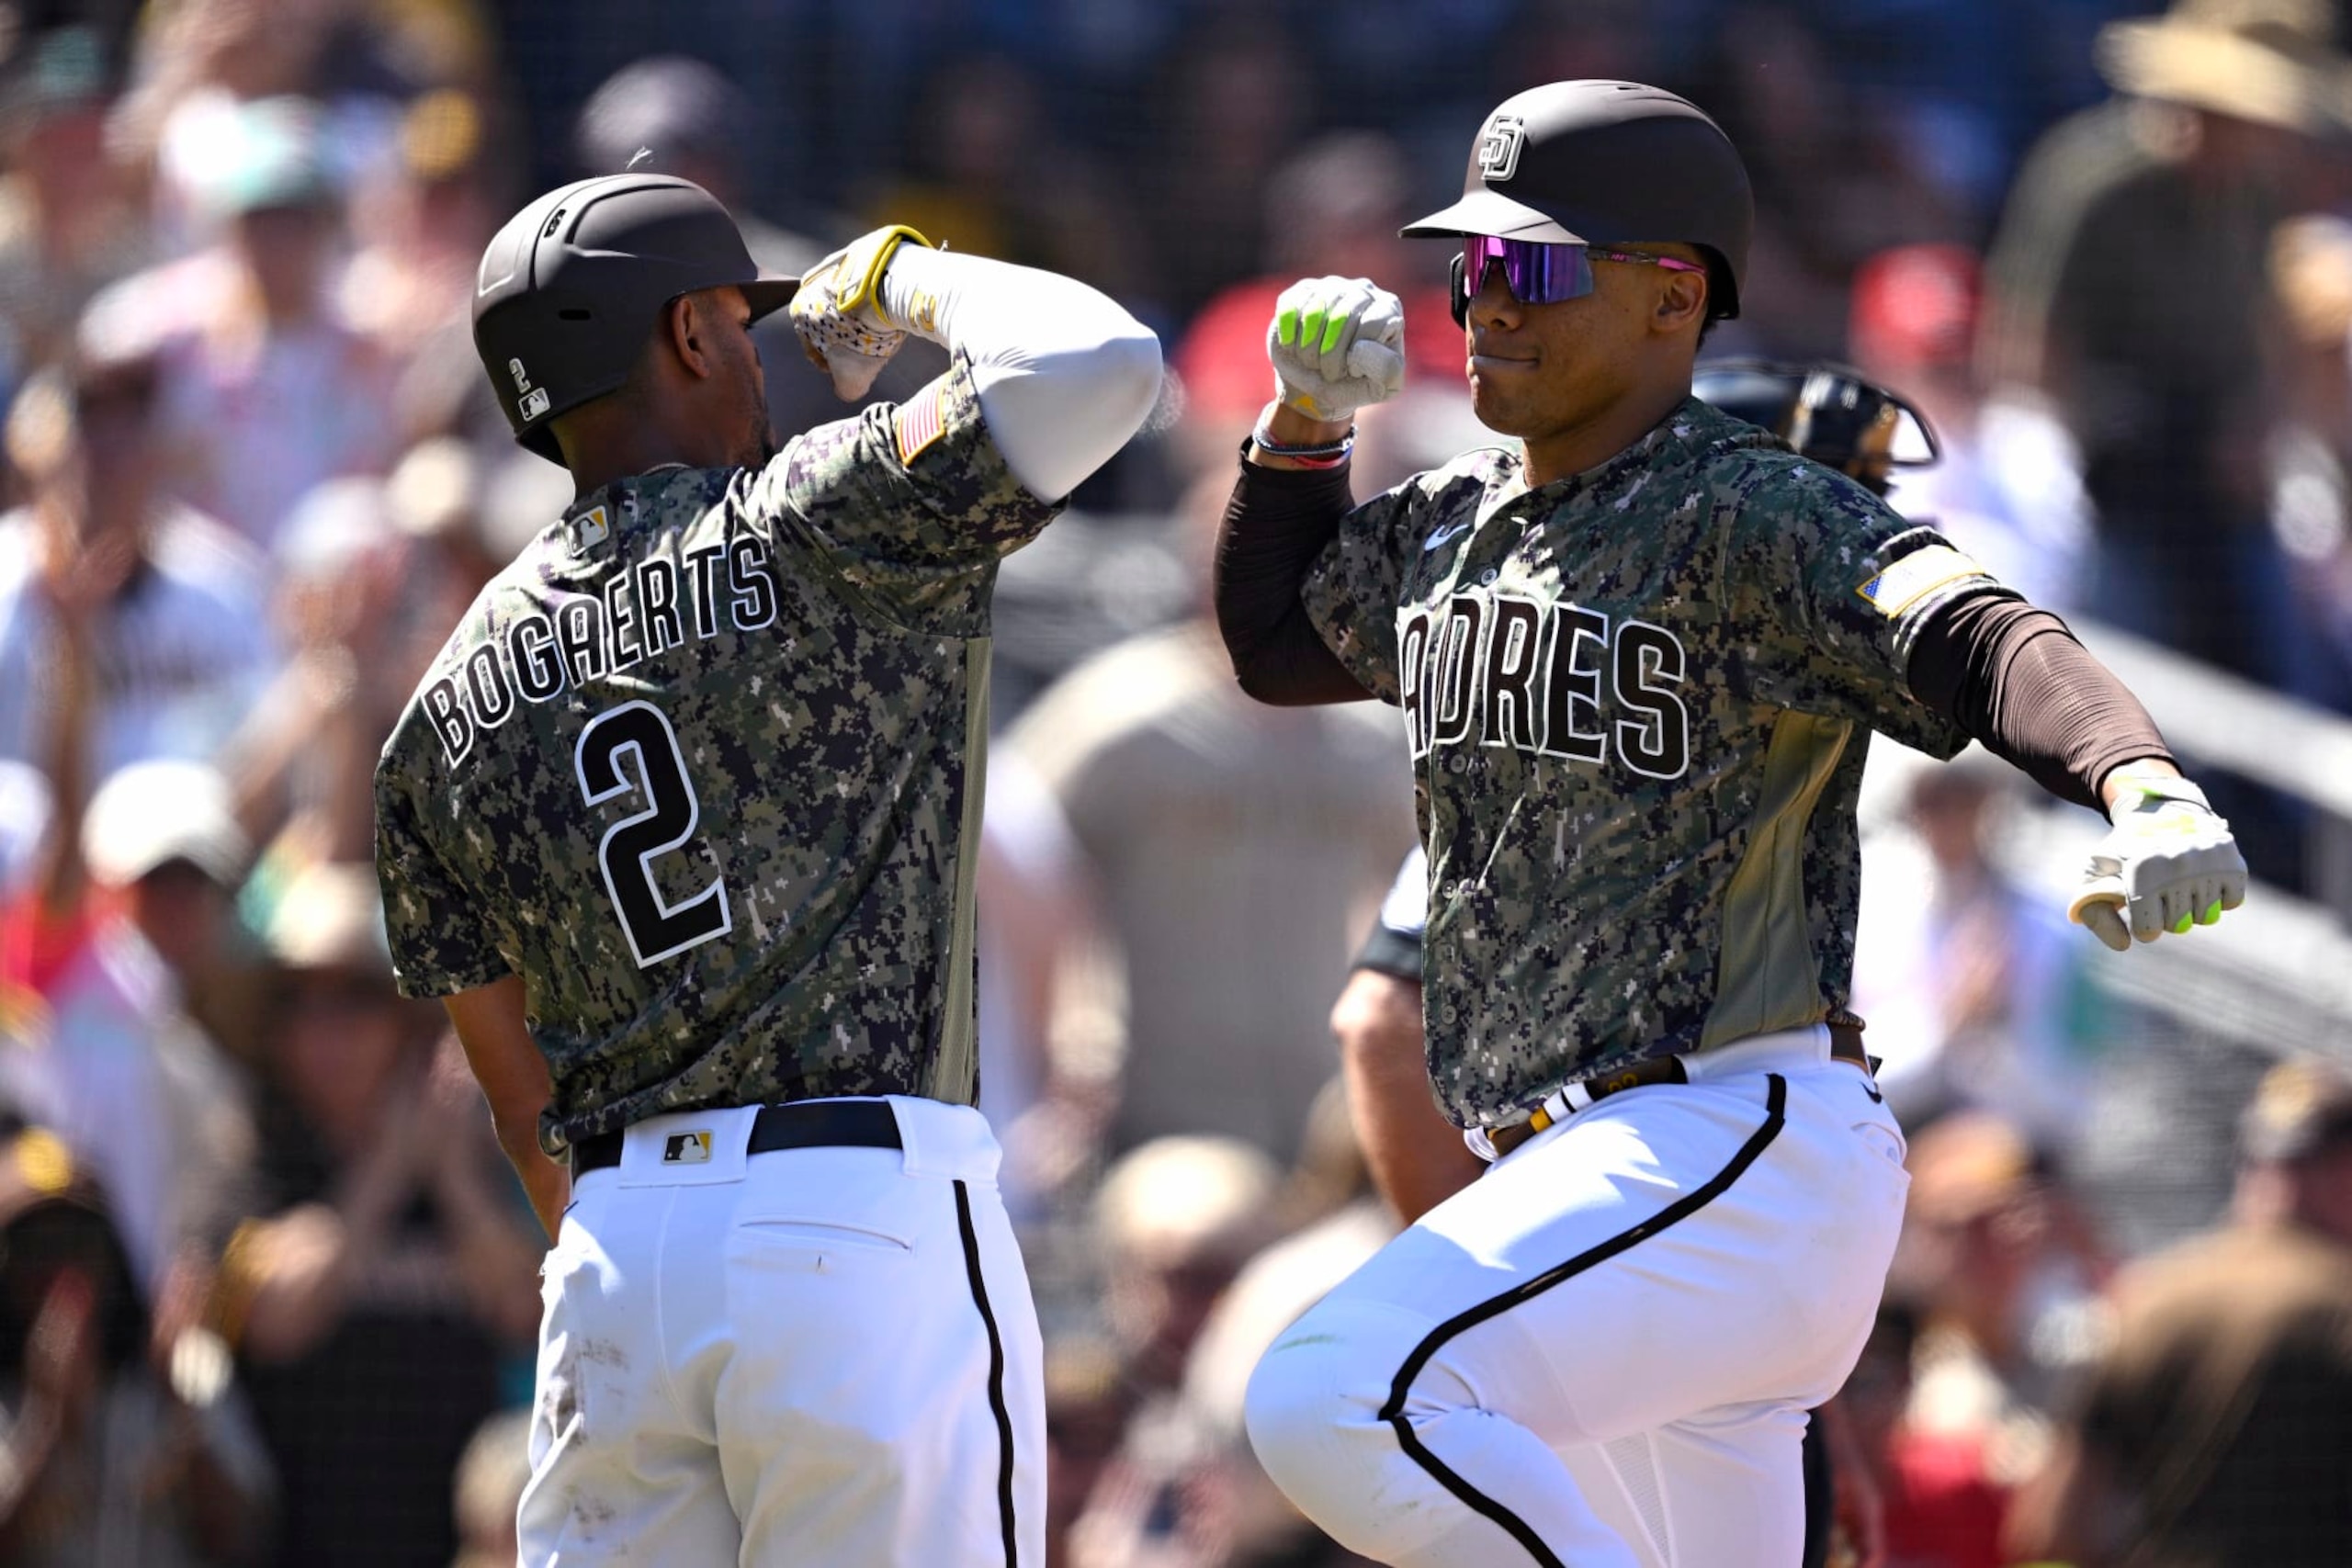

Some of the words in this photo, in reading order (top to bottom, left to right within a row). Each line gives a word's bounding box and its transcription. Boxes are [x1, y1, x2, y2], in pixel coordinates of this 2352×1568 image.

[508, 356, 532, 394] 2
[423, 535, 777, 770] BOGAERTS
[1396, 592, 1690, 780] ADRES
[574, 699, 732, 969] 2
